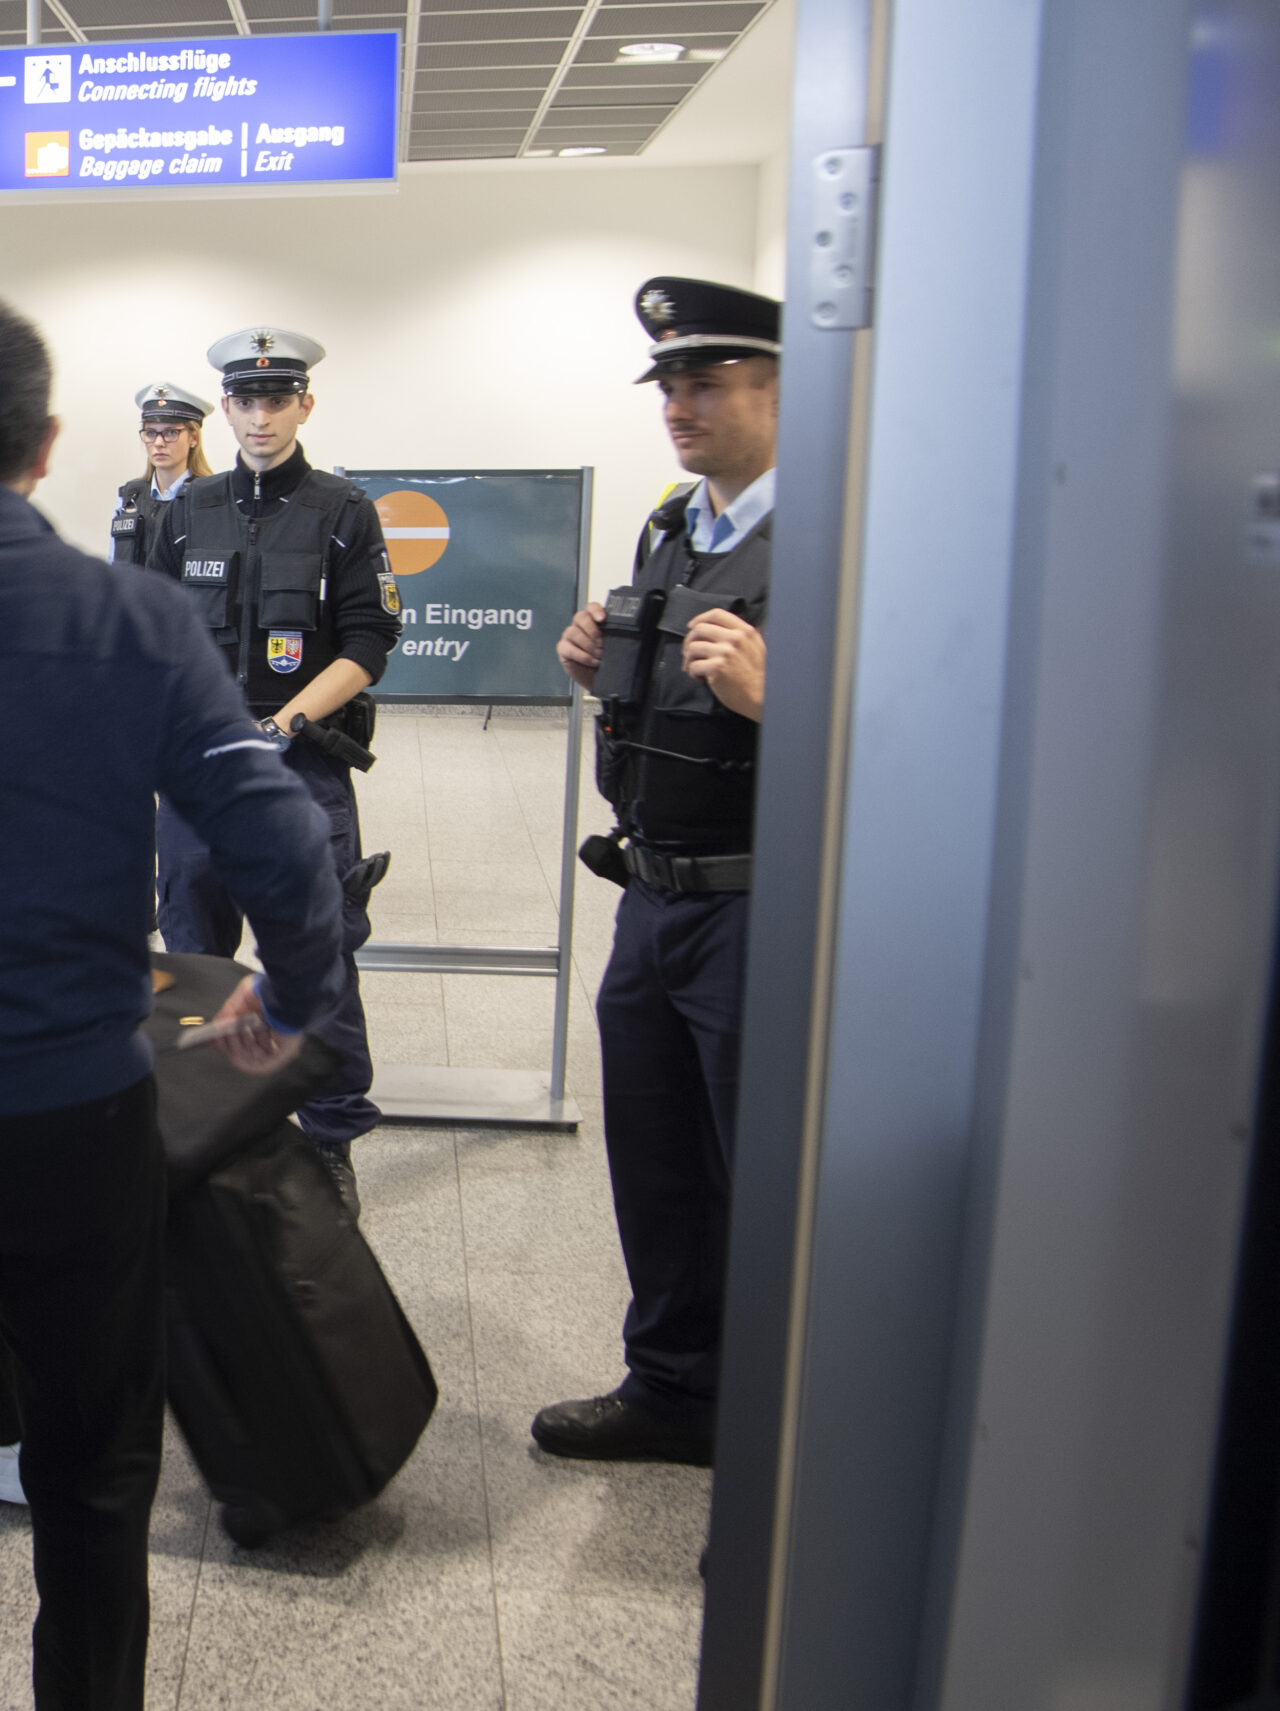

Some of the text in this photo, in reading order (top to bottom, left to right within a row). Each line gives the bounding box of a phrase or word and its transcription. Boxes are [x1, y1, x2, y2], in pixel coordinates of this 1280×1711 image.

[78, 49, 231, 75] Anschlussflüge
[78, 75, 258, 103] Connecting flights
[79, 125, 233, 154] Gepäckausgabe
[255, 122, 345, 147] Ausgang
[79, 153, 223, 181] Baggage claim
[254, 150, 295, 172] Exit
[112, 519, 135, 531] POLIZEI
[185, 560, 225, 577] POLIZEI
[425, 603, 533, 630] Eingang
[402, 636, 470, 662] entry
